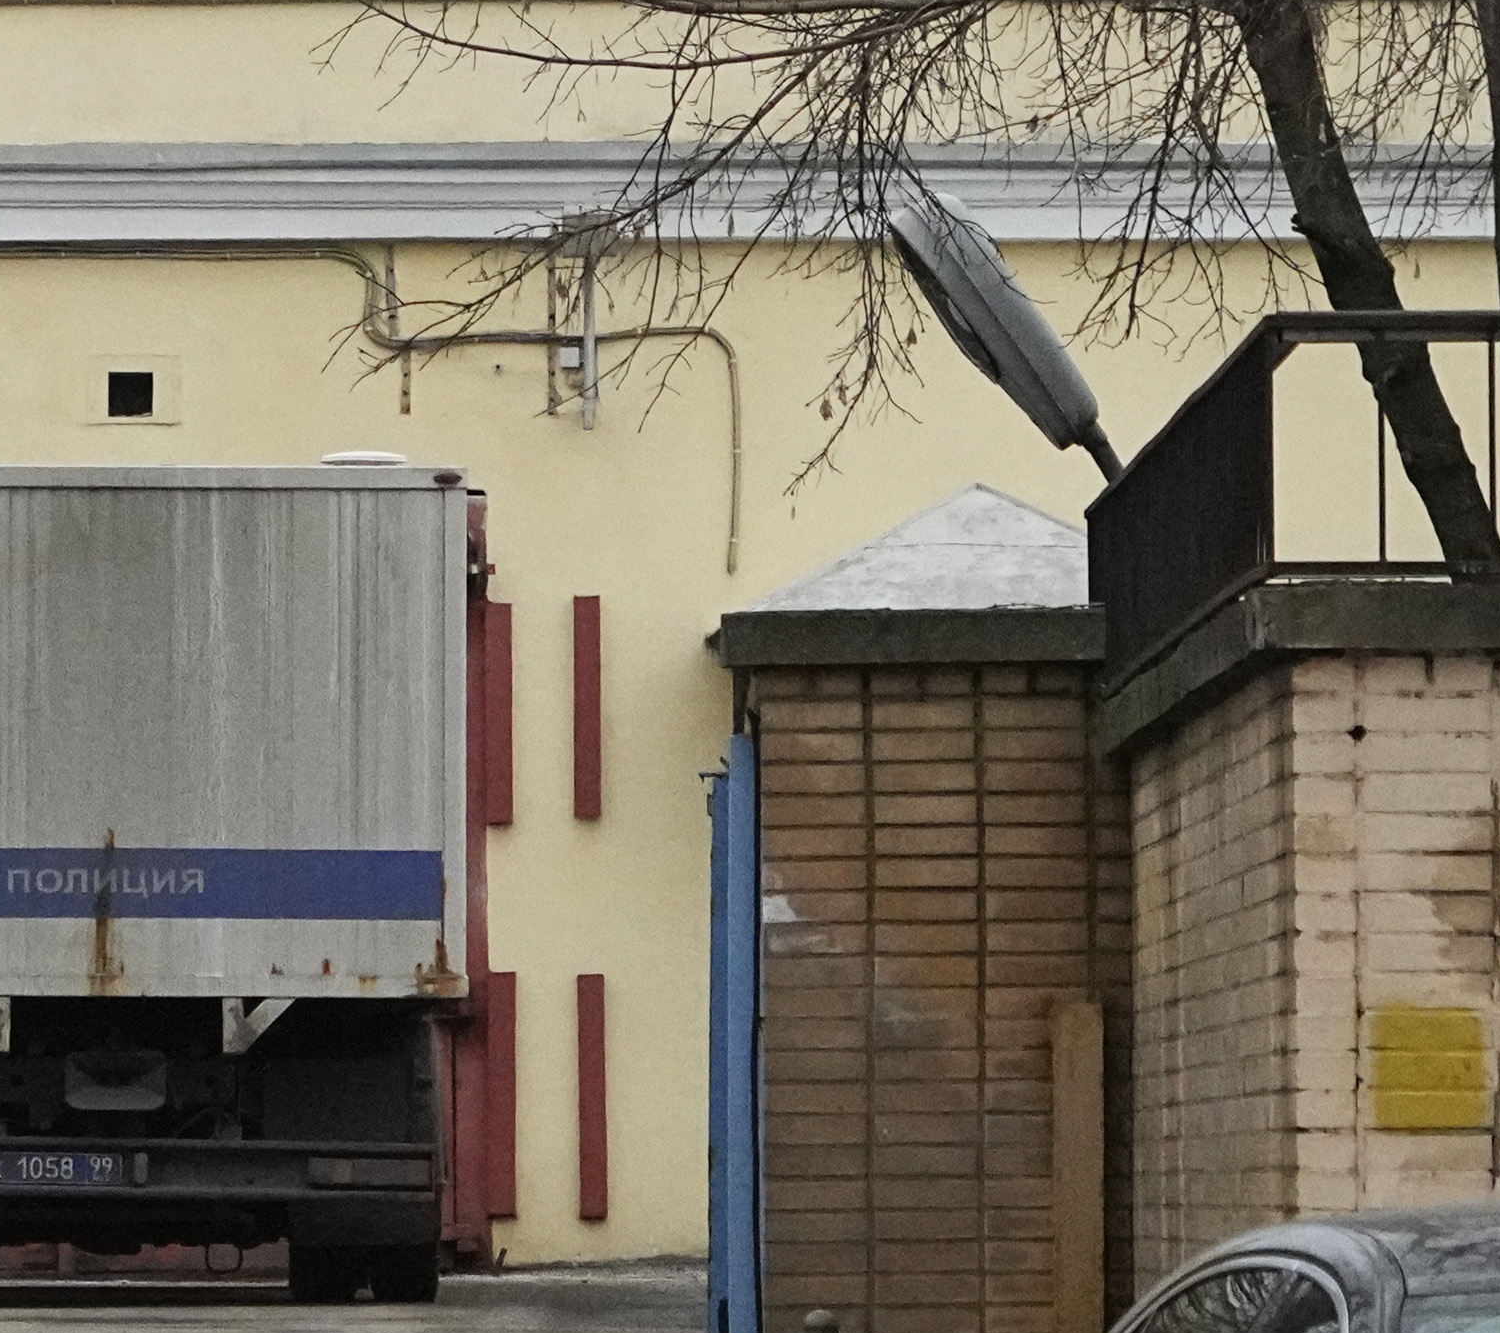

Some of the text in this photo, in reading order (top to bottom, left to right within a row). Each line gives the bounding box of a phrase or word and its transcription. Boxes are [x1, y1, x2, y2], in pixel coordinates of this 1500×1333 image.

[7, 868, 205, 899] ПОЛИЦИЯ
[16, 1156, 75, 1180] 1058
[89, 1156, 114, 1174] 99
